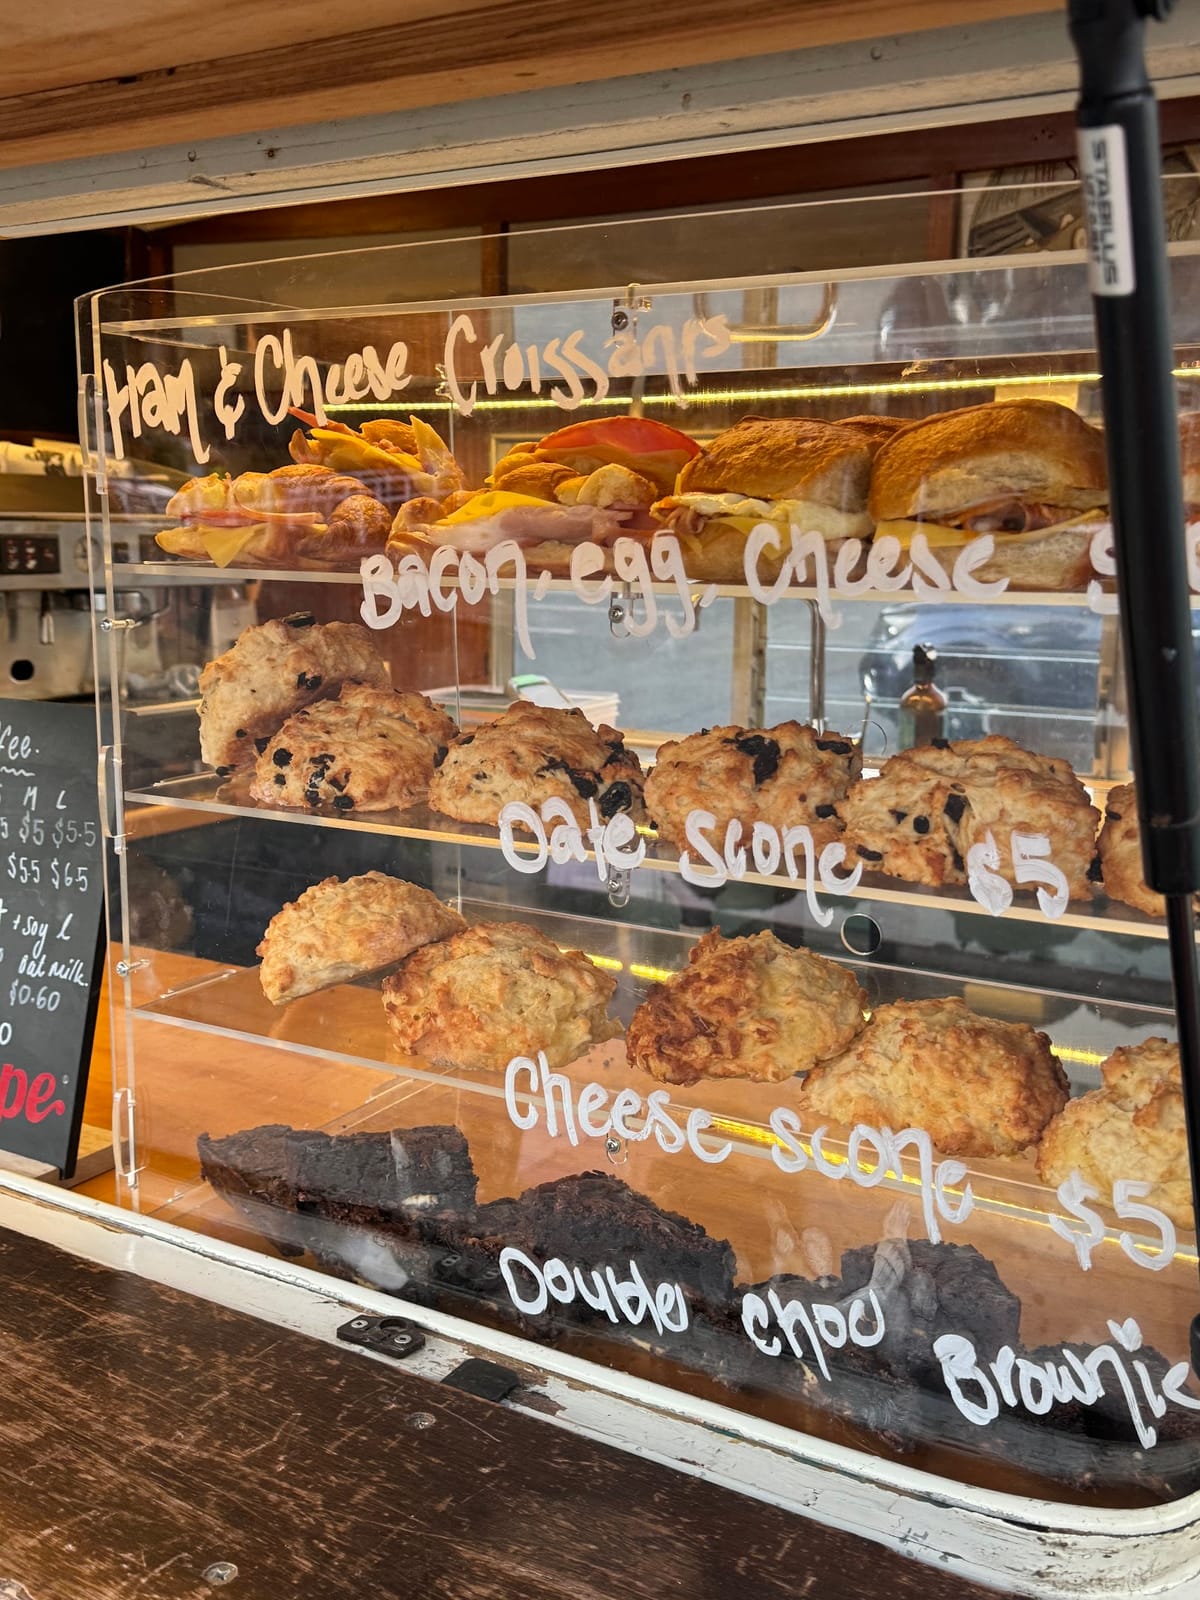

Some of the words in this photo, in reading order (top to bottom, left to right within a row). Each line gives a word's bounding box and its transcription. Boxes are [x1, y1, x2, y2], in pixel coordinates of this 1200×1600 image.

[1092, 140, 1119, 286] STABILUS
[102, 358, 211, 465] Ham
[214, 345, 245, 441] &
[254, 327, 413, 427] Cheese
[19, 810, 45, 846] $5
[56, 790, 67, 809] L
[498, 796, 646, 882] Date
[967, 829, 1069, 919] $5
[10, 978, 61, 1012] $0.60
[1048, 1171, 1177, 1271] $5
[499, 1246, 689, 1337] Double
[933, 1317, 1200, 1450] Brownie
